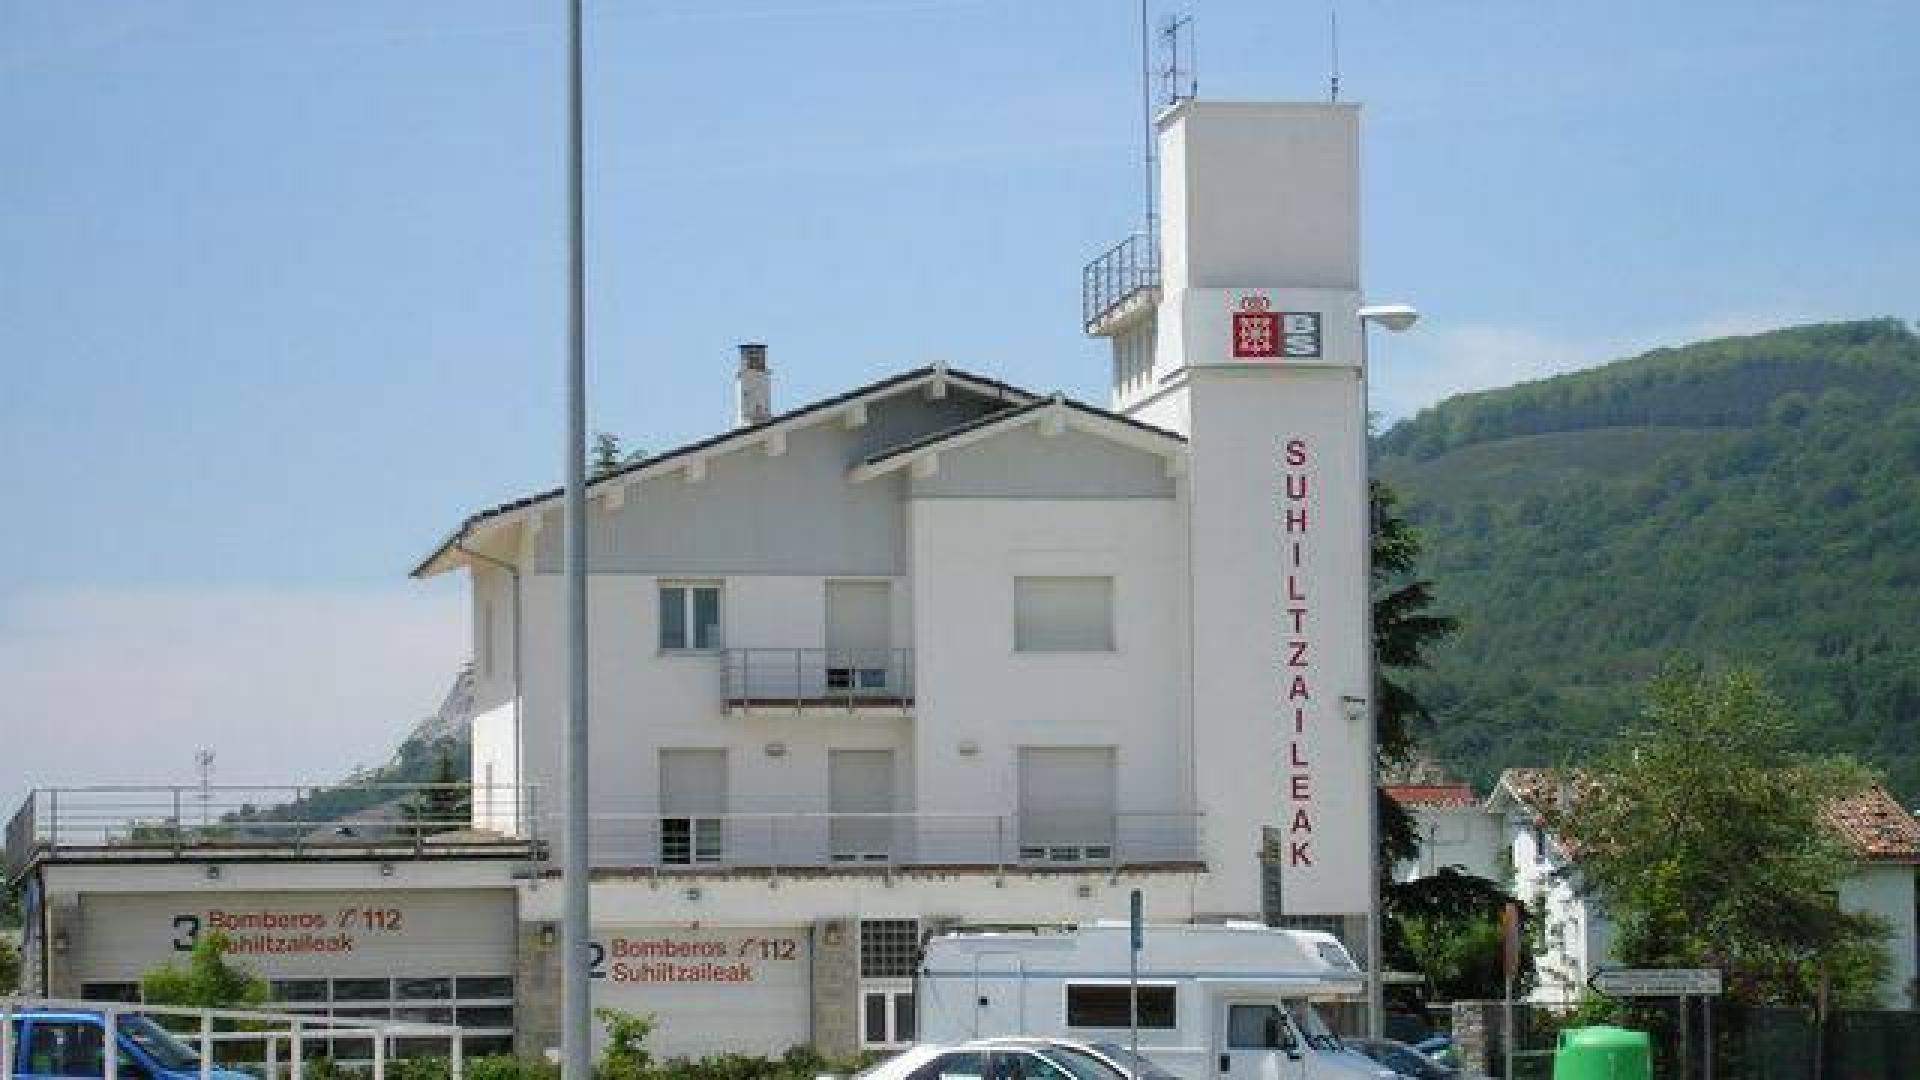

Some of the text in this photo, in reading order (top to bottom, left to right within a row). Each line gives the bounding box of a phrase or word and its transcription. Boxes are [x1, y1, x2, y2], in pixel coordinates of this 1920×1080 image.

[1285, 440, 1312, 867] SUHILTZAILEAK
[173, 914, 199, 952] 3
[208, 908, 402, 931] Bomberos 112
[587, 942, 607, 979] 2
[611, 938, 796, 960] Bomberos 112
[612, 962, 754, 982] Suhiltzaileak
